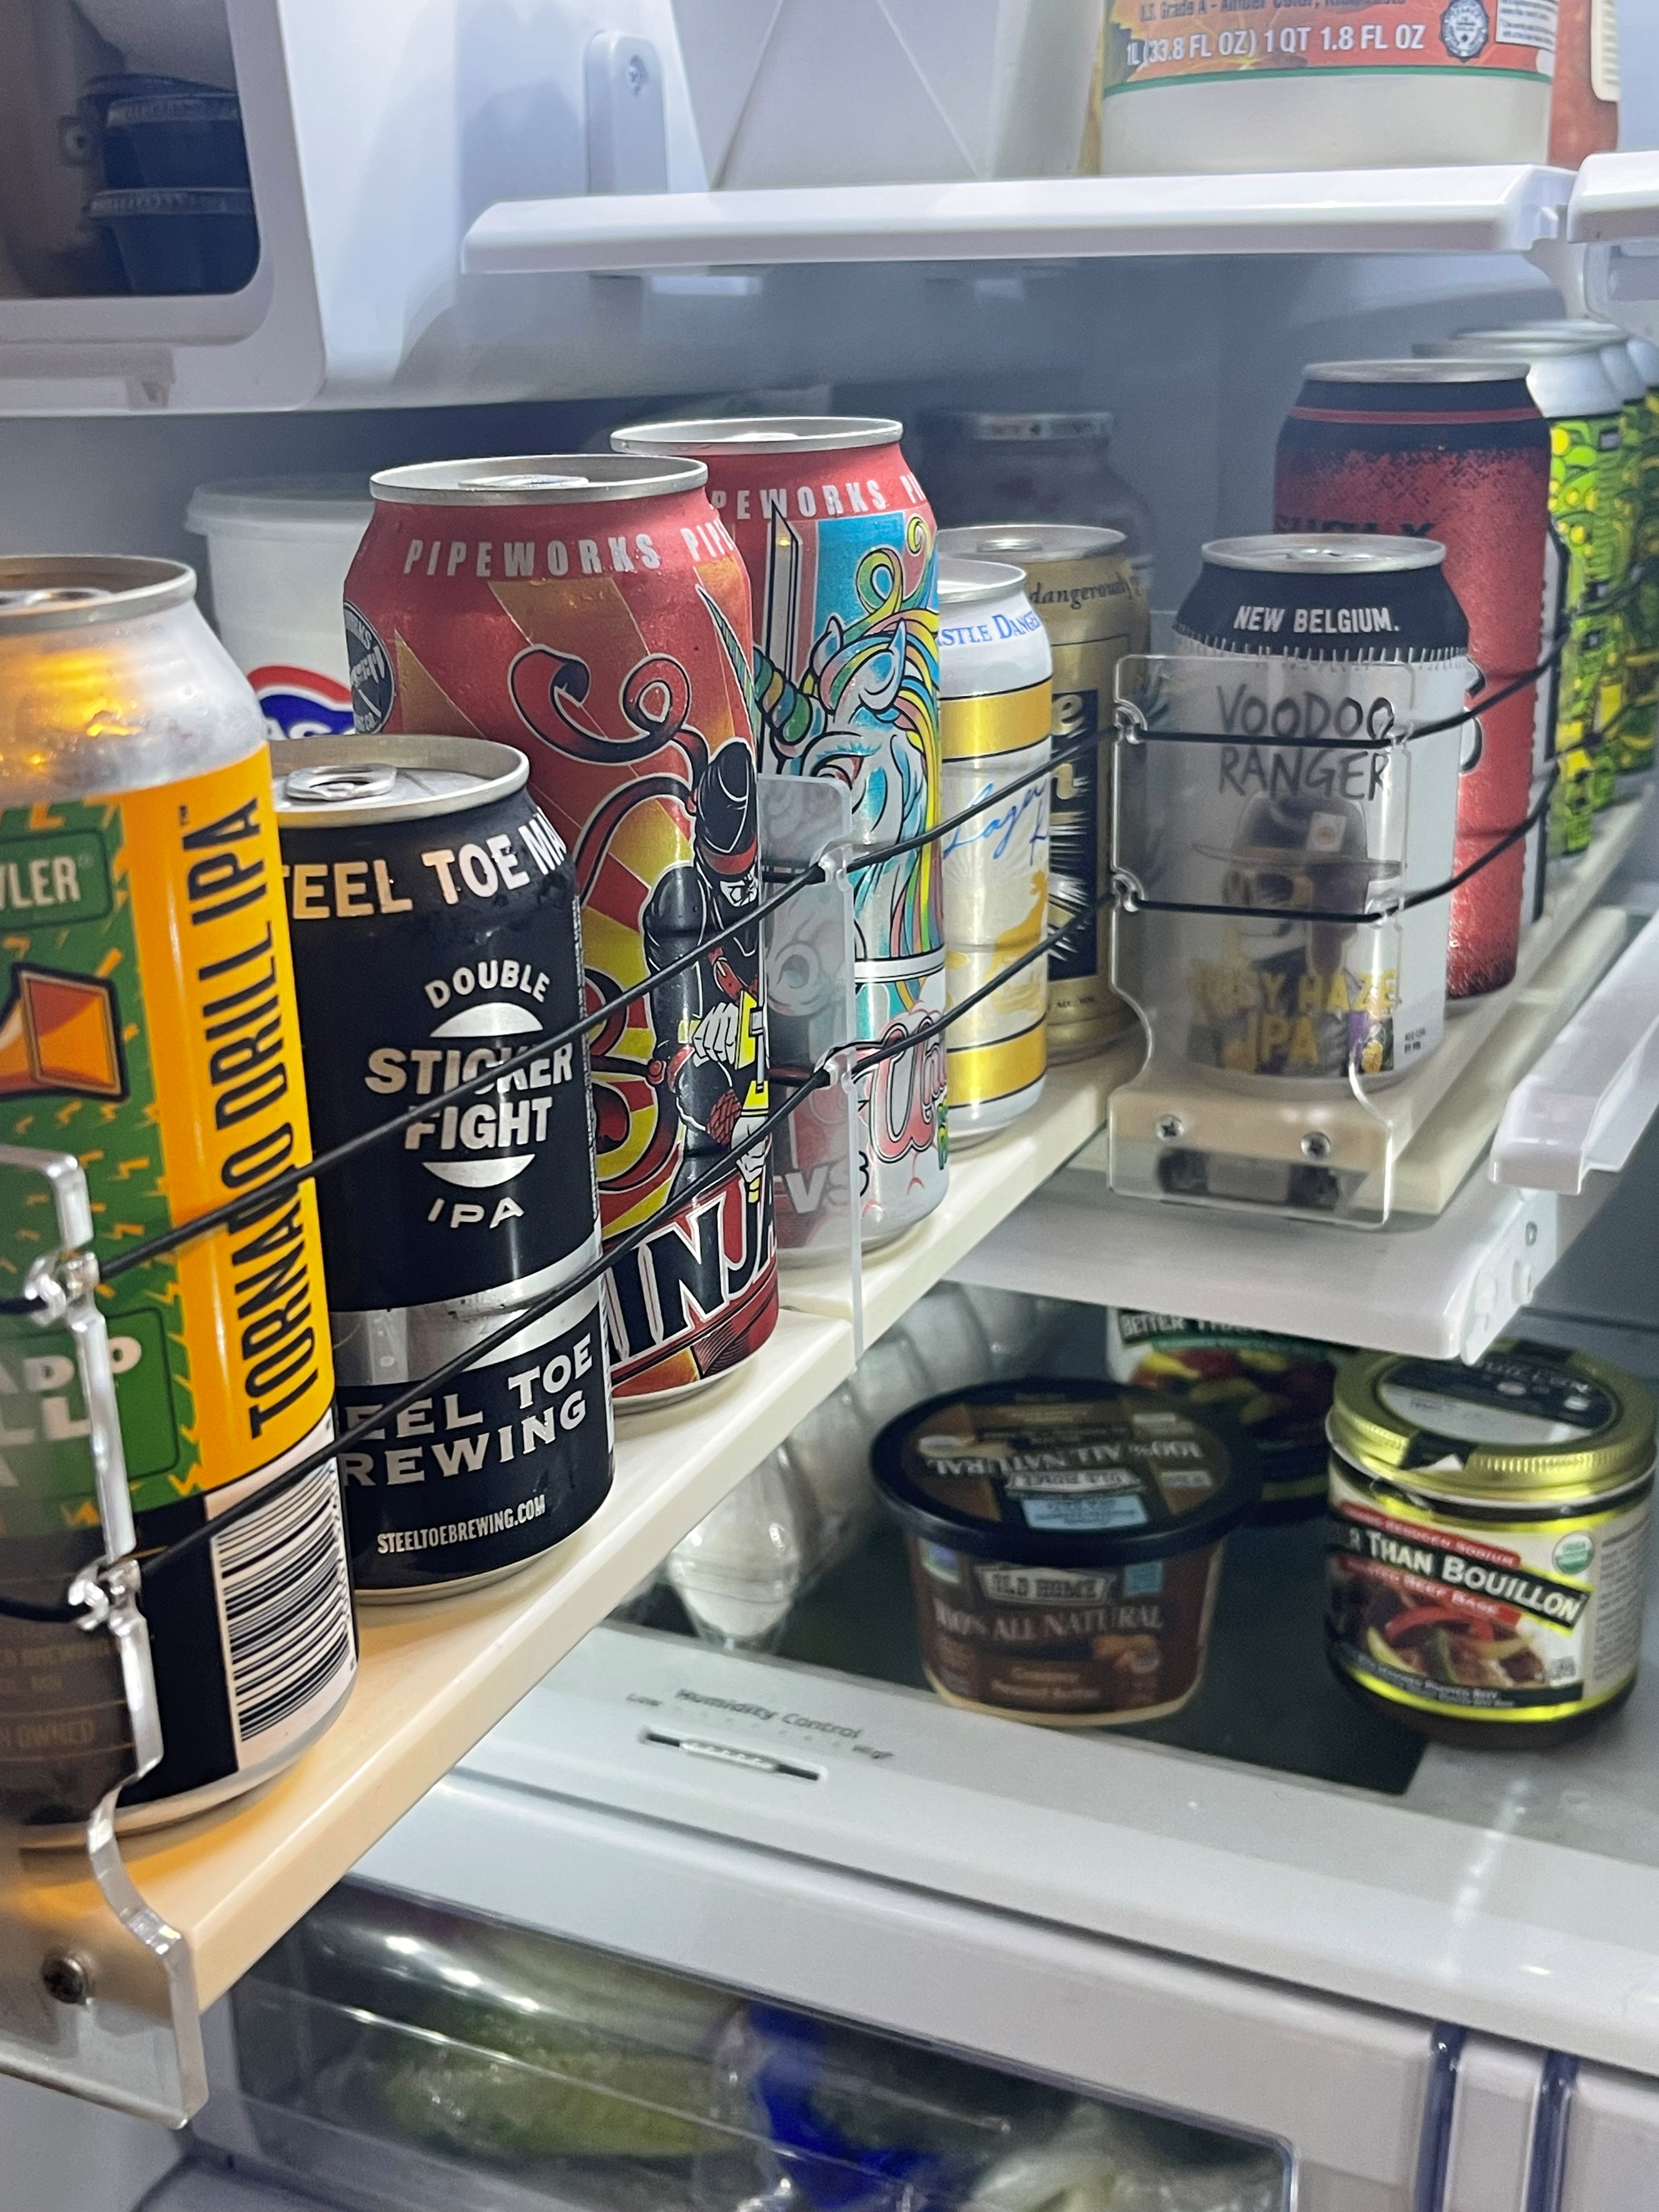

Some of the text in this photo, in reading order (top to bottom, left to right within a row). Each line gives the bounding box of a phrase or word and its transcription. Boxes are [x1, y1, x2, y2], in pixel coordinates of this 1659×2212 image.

[1143, 37, 1184, 64] (33.8
[1189, 34, 1211, 59] FL
[1218, 29, 1256, 58] OZ)
[1279, 26, 1312, 54] QT
[1321, 26, 1354, 50] 1.8
[1361, 25, 1388, 49] FL
[1395, 24, 1426, 49] OZ
[403, 533, 661, 578] PIPEWORKS
[1233, 605, 1285, 632] NEW
[1216, 682, 1395, 741] VOODOO
[1218, 744, 1390, 802] RANGER
[0, 855, 82, 911] LER
[181, 797, 267, 926] IPA
[283, 859, 413, 920] EEL
[421, 833, 531, 905] TOE
[425, 959, 550, 1009] DOUBLE
[198, 920, 289, 1131] DRILL
[364, 1043, 573, 1096] STICKER
[404, 1096, 553, 1151] FIGHT
[427, 1197, 525, 1229] IPA
[507, 1332, 593, 1410] TOE
[1074, 1443, 1122, 1464] ALL
[377, 1493, 545, 1554] STEELTOEBREWING.COM
[1366, 1530, 1434, 1577] THAN
[1441, 1555, 1583, 1622] BOUILLON
[993, 1616, 1040, 1642] ALL
[1042, 1604, 1163, 1639] NATURAL
[781, 1713, 862, 1740] Control
